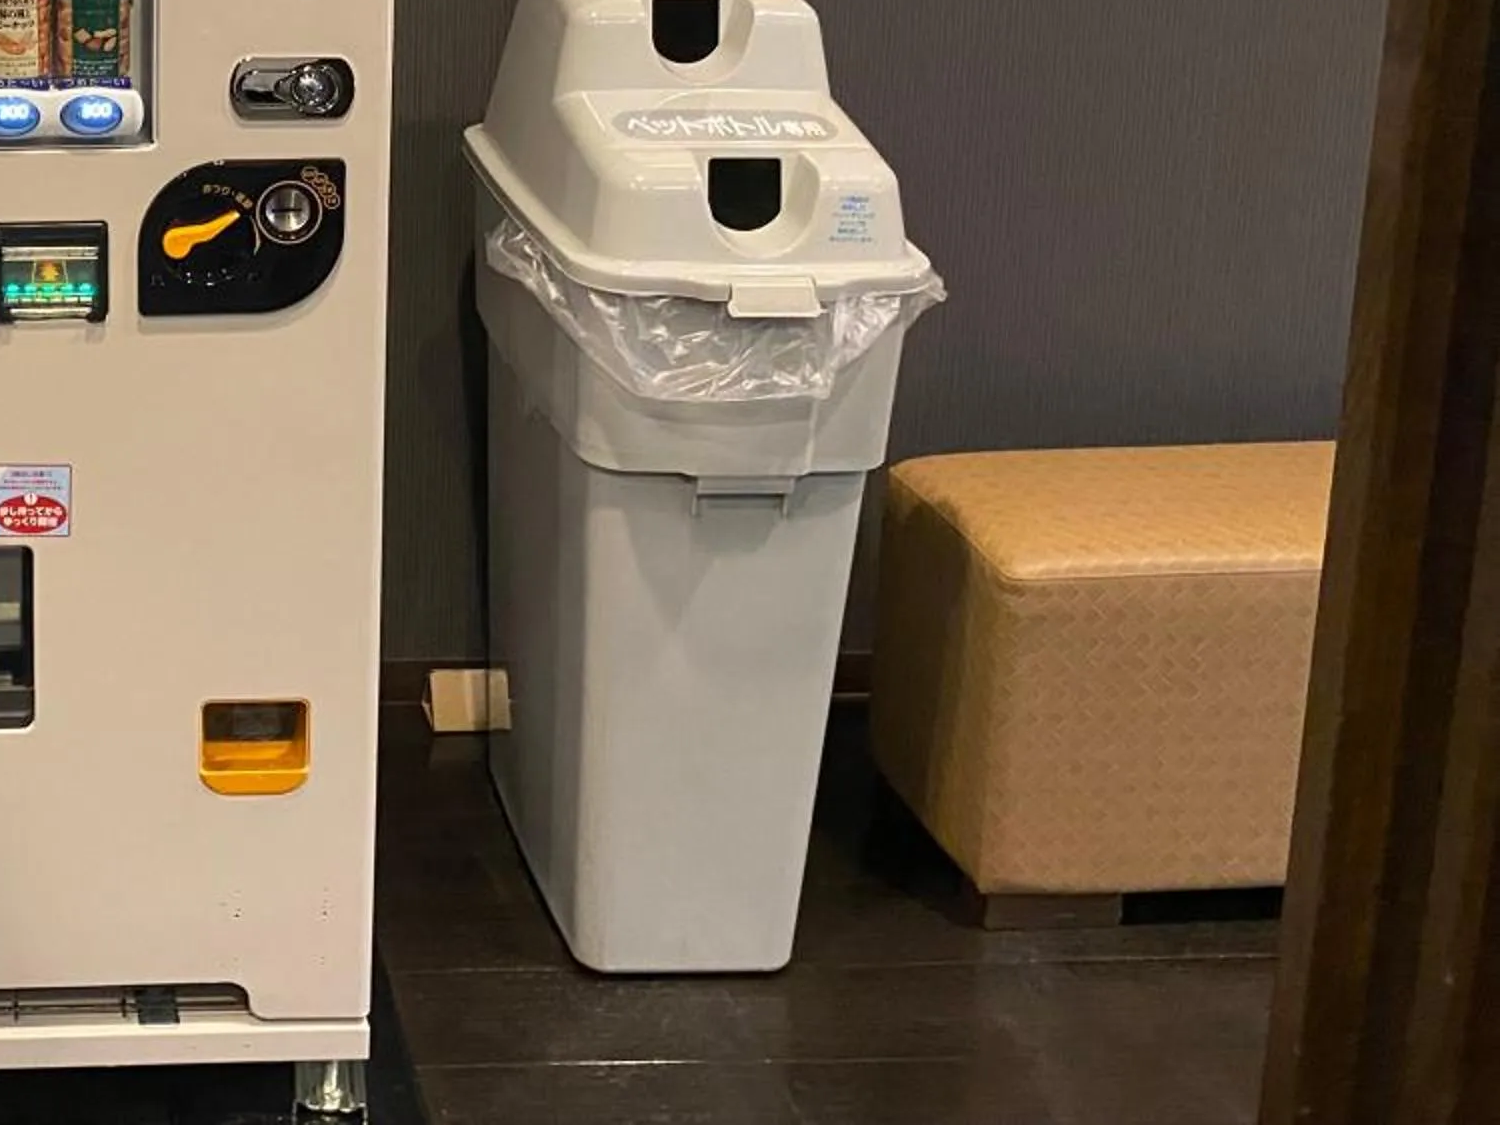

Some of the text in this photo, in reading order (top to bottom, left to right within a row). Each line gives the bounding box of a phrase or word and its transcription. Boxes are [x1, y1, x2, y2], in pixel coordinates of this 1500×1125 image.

[627, 114, 828, 138] ペットボトル専用
